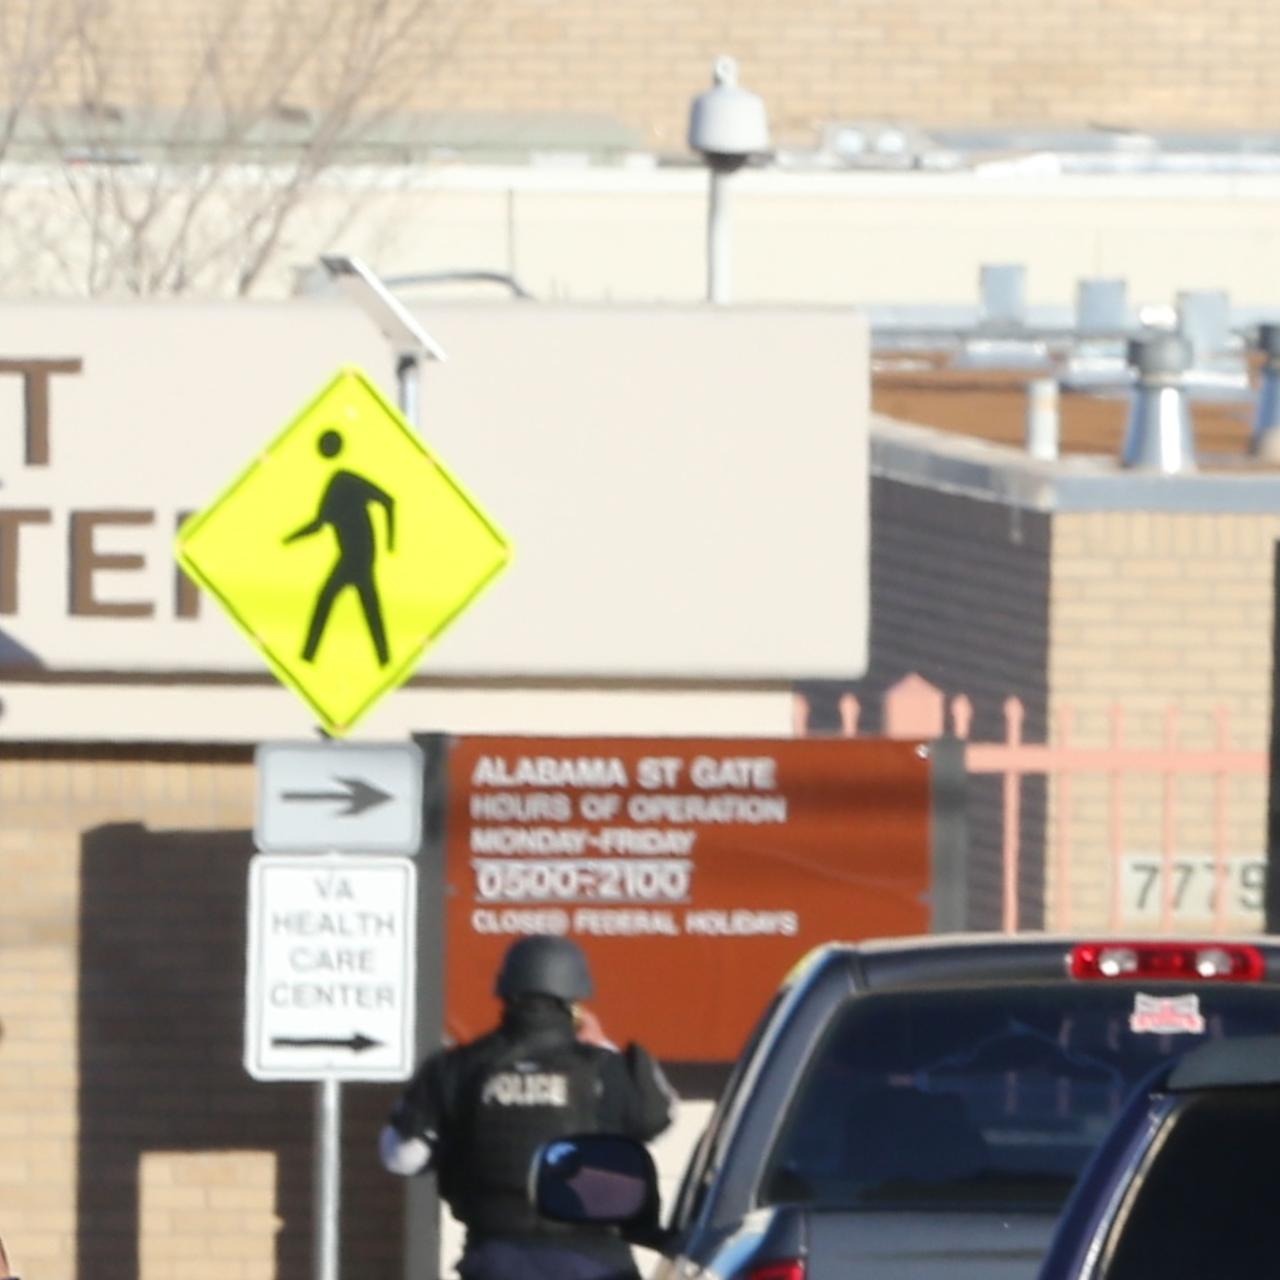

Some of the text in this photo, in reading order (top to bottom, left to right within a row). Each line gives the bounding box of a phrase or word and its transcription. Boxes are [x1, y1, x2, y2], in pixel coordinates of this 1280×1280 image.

[472, 757, 777, 789] ALABAMA ST GATE
[470, 793, 786, 823] HOURS OF OPERATION
[313, 876, 355, 901] VA
[272, 911, 396, 938] HEALTH
[472, 908, 798, 936] CLOSED FEDERAL HOLIDAYS
[290, 947, 373, 974] CARE
[271, 981, 396, 1009] CENTER
